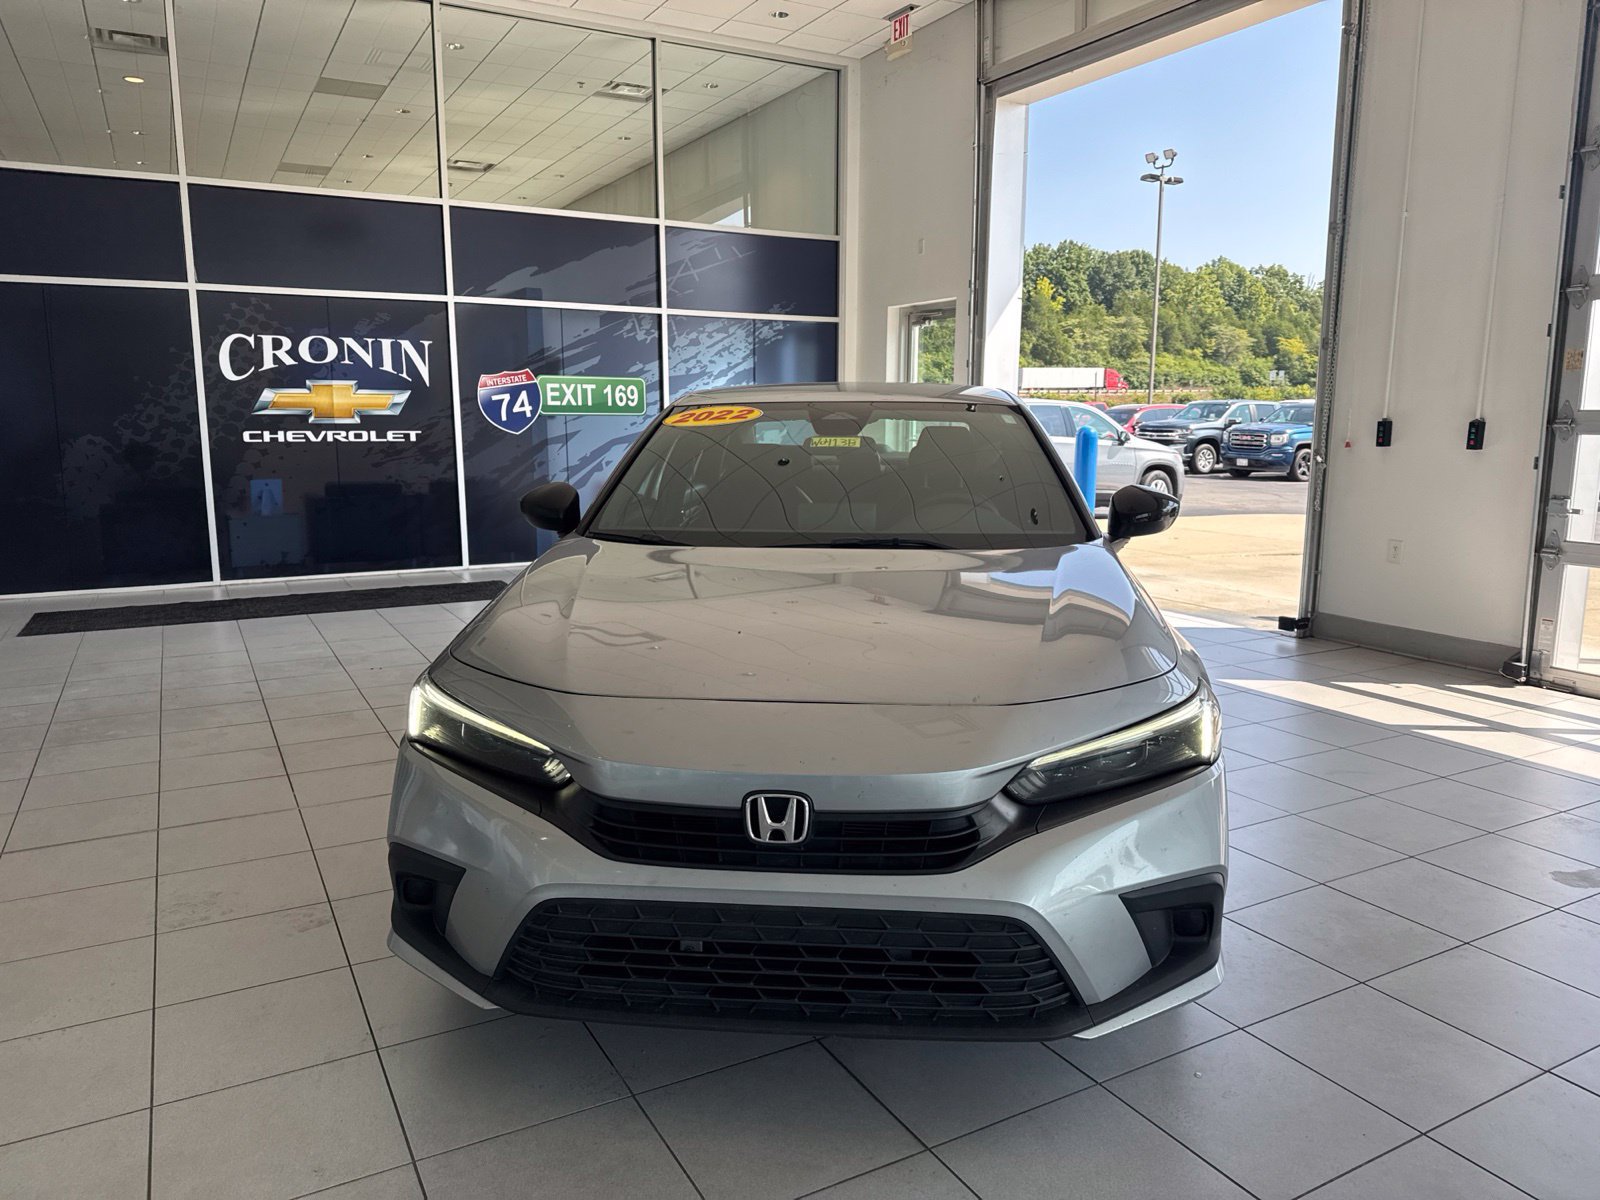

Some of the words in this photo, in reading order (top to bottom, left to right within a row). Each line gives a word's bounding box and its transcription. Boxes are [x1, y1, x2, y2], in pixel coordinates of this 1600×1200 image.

[893, 14, 909, 41] EXIT
[218, 333, 433, 387] CRONIN
[486, 373, 528, 386] INTERSTATE
[491, 390, 533, 422] 74
[546, 383, 596, 407] EXIT
[603, 384, 639, 407] 169
[671, 408, 755, 424] 2022
[242, 430, 422, 443] CHEVROLET
